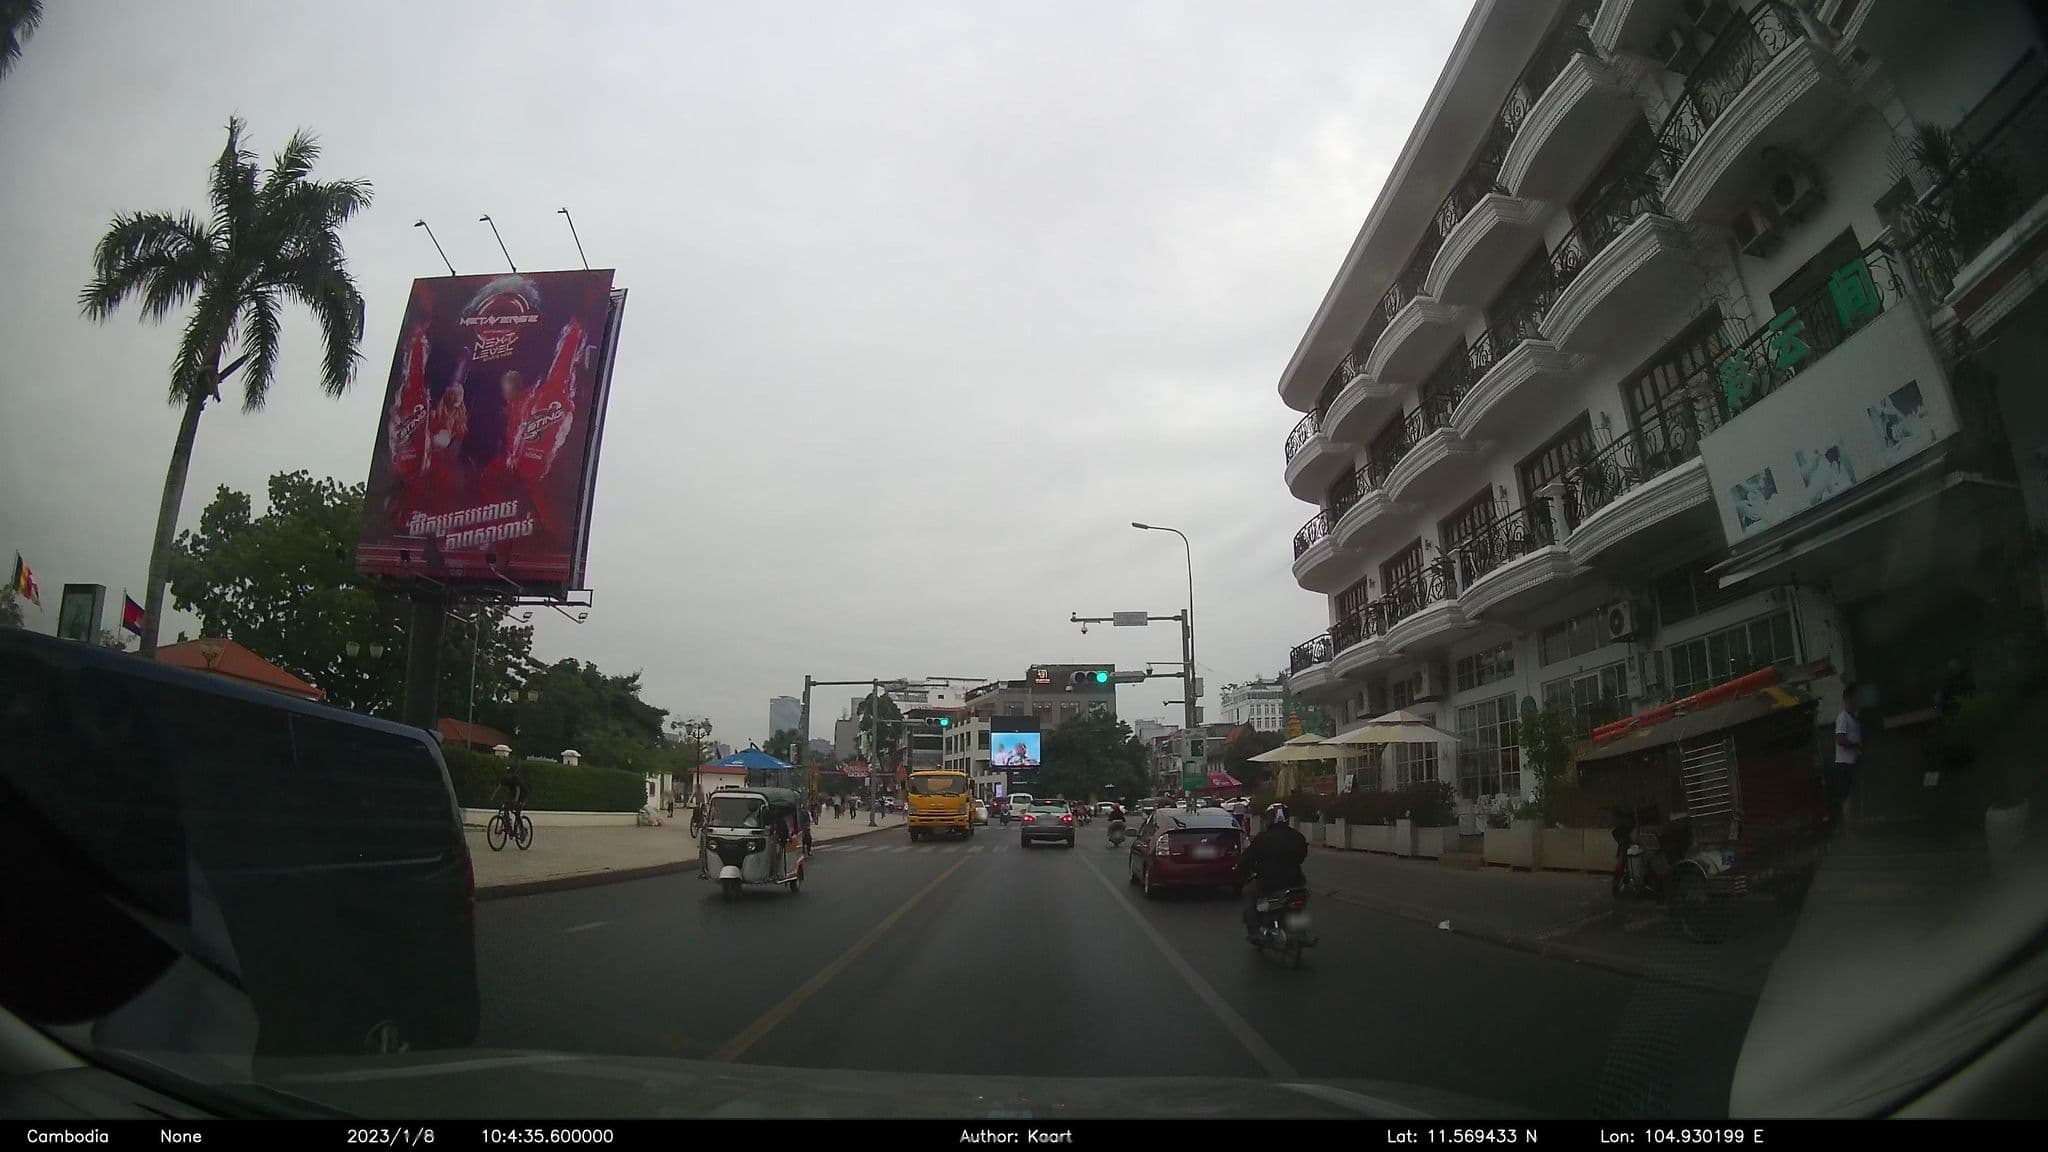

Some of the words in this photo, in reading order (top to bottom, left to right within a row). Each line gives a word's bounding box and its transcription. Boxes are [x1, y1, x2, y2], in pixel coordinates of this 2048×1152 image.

[459, 314, 539, 327] METAVERSE
[474, 332, 519, 351] NEXT
[472, 344, 514, 361] LEVEL
[526, 409, 564, 432] STING
